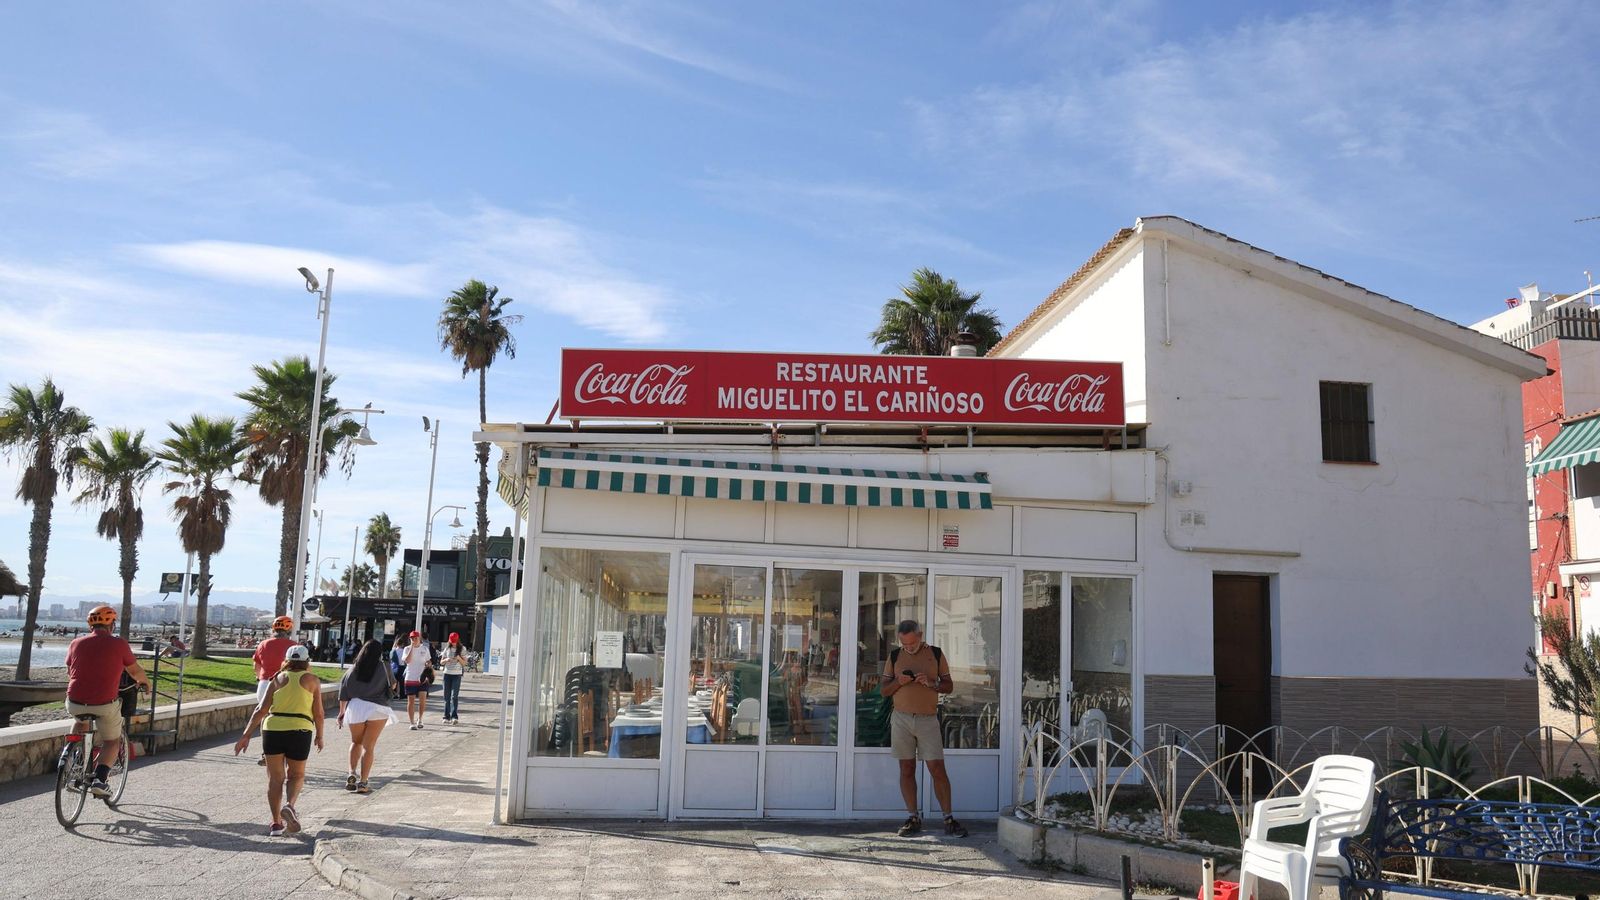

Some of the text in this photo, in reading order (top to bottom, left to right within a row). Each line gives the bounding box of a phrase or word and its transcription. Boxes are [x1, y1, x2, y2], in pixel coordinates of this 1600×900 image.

[574, 362, 695, 405] Coca-Cola
[776, 362, 928, 385] RESTAURANTE
[717, 385, 984, 414] MIGUELITO EL CARIÑOSO
[1004, 372, 1110, 412] Coca-Cola
